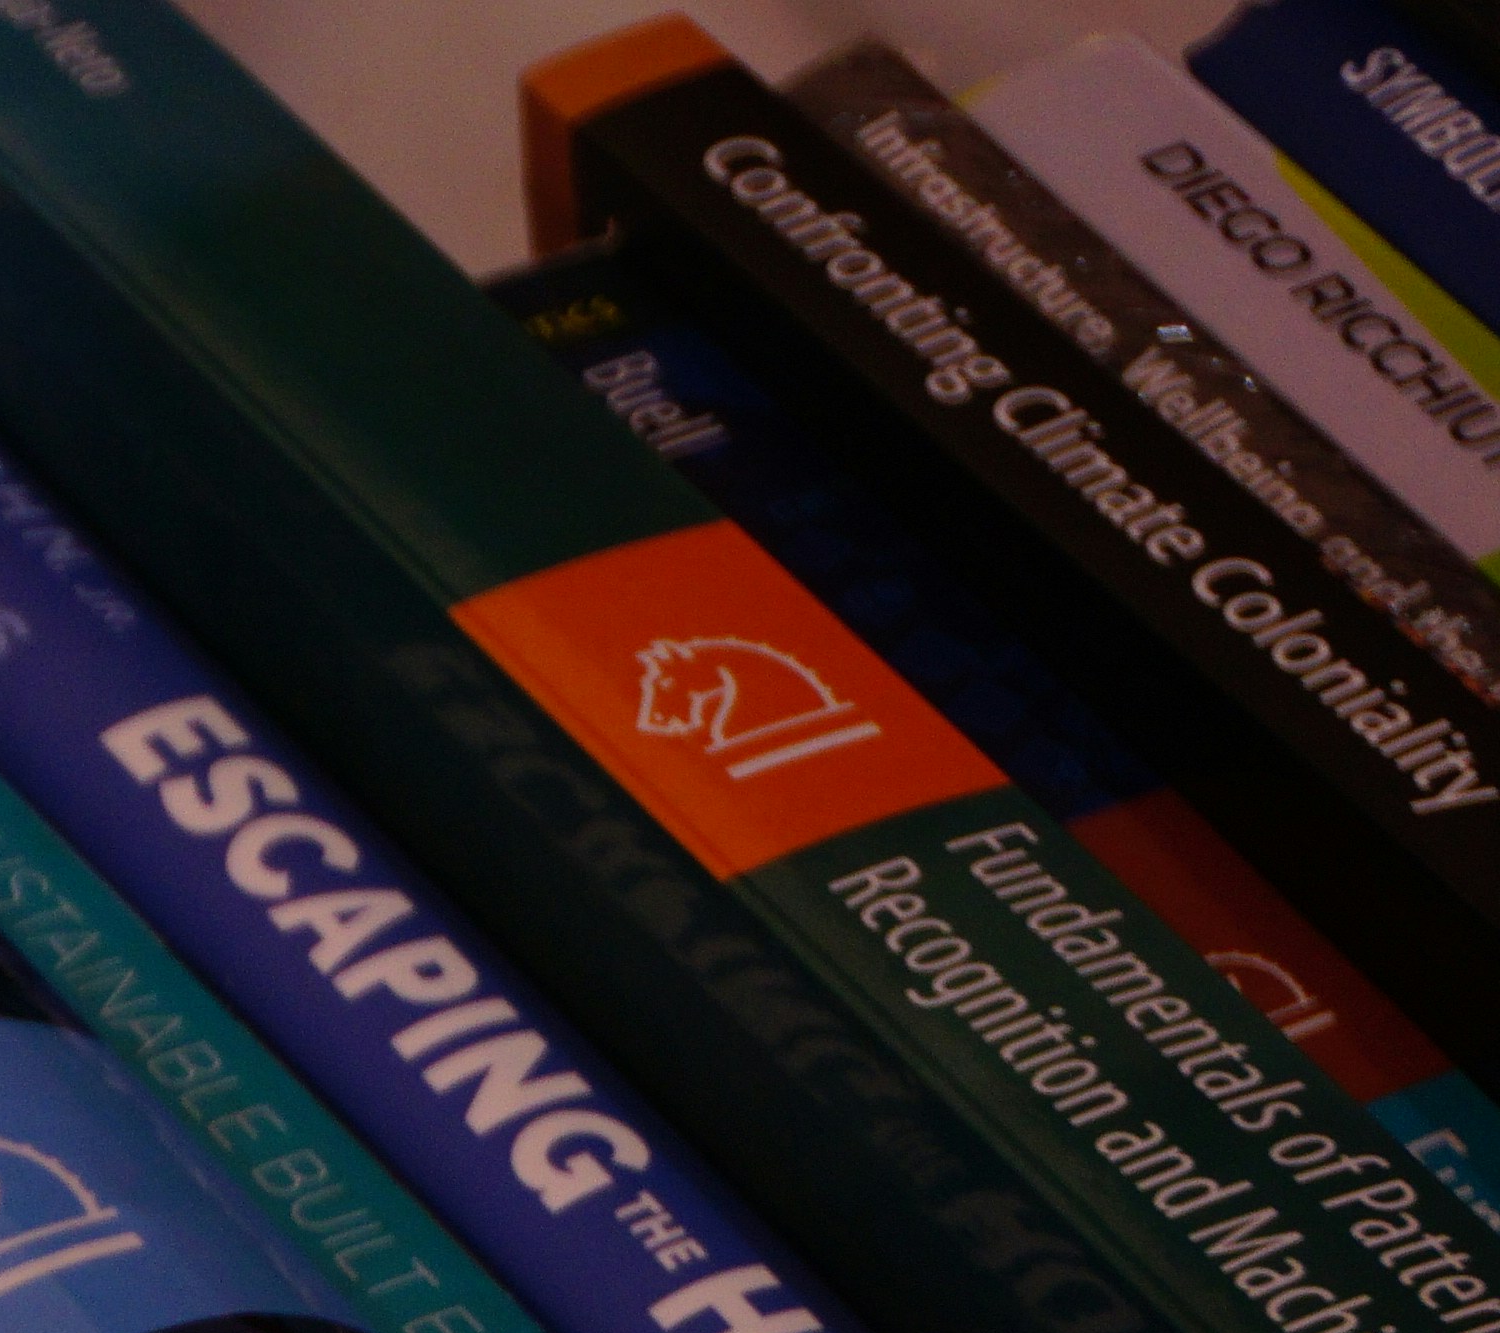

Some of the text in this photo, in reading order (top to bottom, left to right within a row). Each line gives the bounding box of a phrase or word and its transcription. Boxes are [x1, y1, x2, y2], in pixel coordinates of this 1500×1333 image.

[703, 134, 1498, 815] Confronting Climate Coloniality
[1141, 140, 1500, 468] DIEGO RICCHIU
[101, 692, 651, 1214] ESCAPING
[615, 1194, 709, 1272] THE
[829, 855, 1130, 1129] Recognition
[1098, 1117, 1252, 1223] and
[946, 821, 1306, 1134] Fundamentals
[1269, 1126, 1388, 1189] of
[252, 1146, 440, 1296] BUILT
